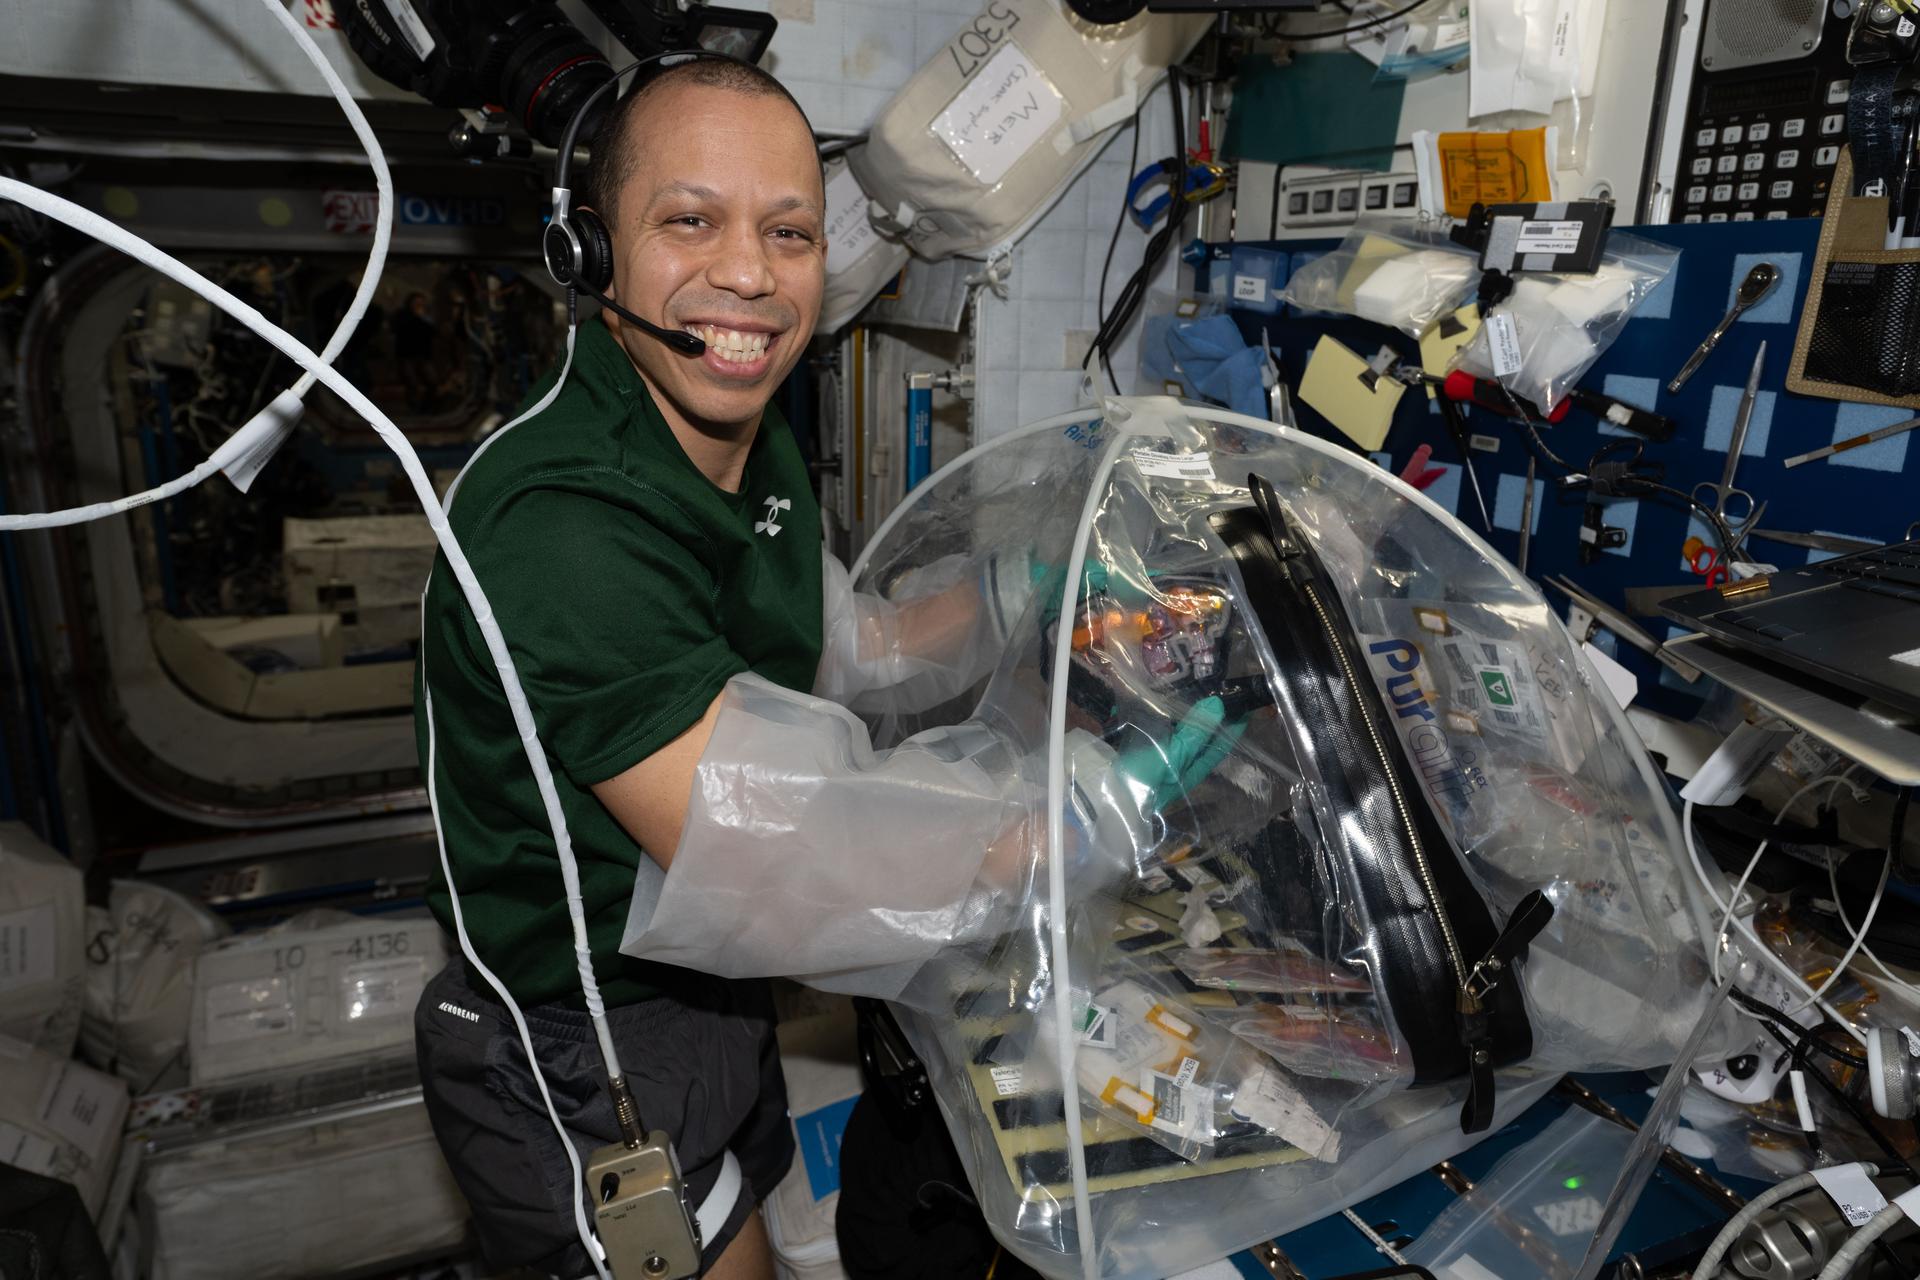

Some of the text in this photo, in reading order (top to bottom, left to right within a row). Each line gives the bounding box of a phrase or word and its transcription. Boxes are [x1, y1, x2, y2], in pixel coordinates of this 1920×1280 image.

[949, 1, 1020, 78] 5307
[1866, 92, 1877, 147] TIKKA
[403, 197, 504, 224] OVHD
[1063, 424, 1086, 442] Air
[273, 944, 305, 972] 10
[438, 1001, 480, 1023] AEROREADY
